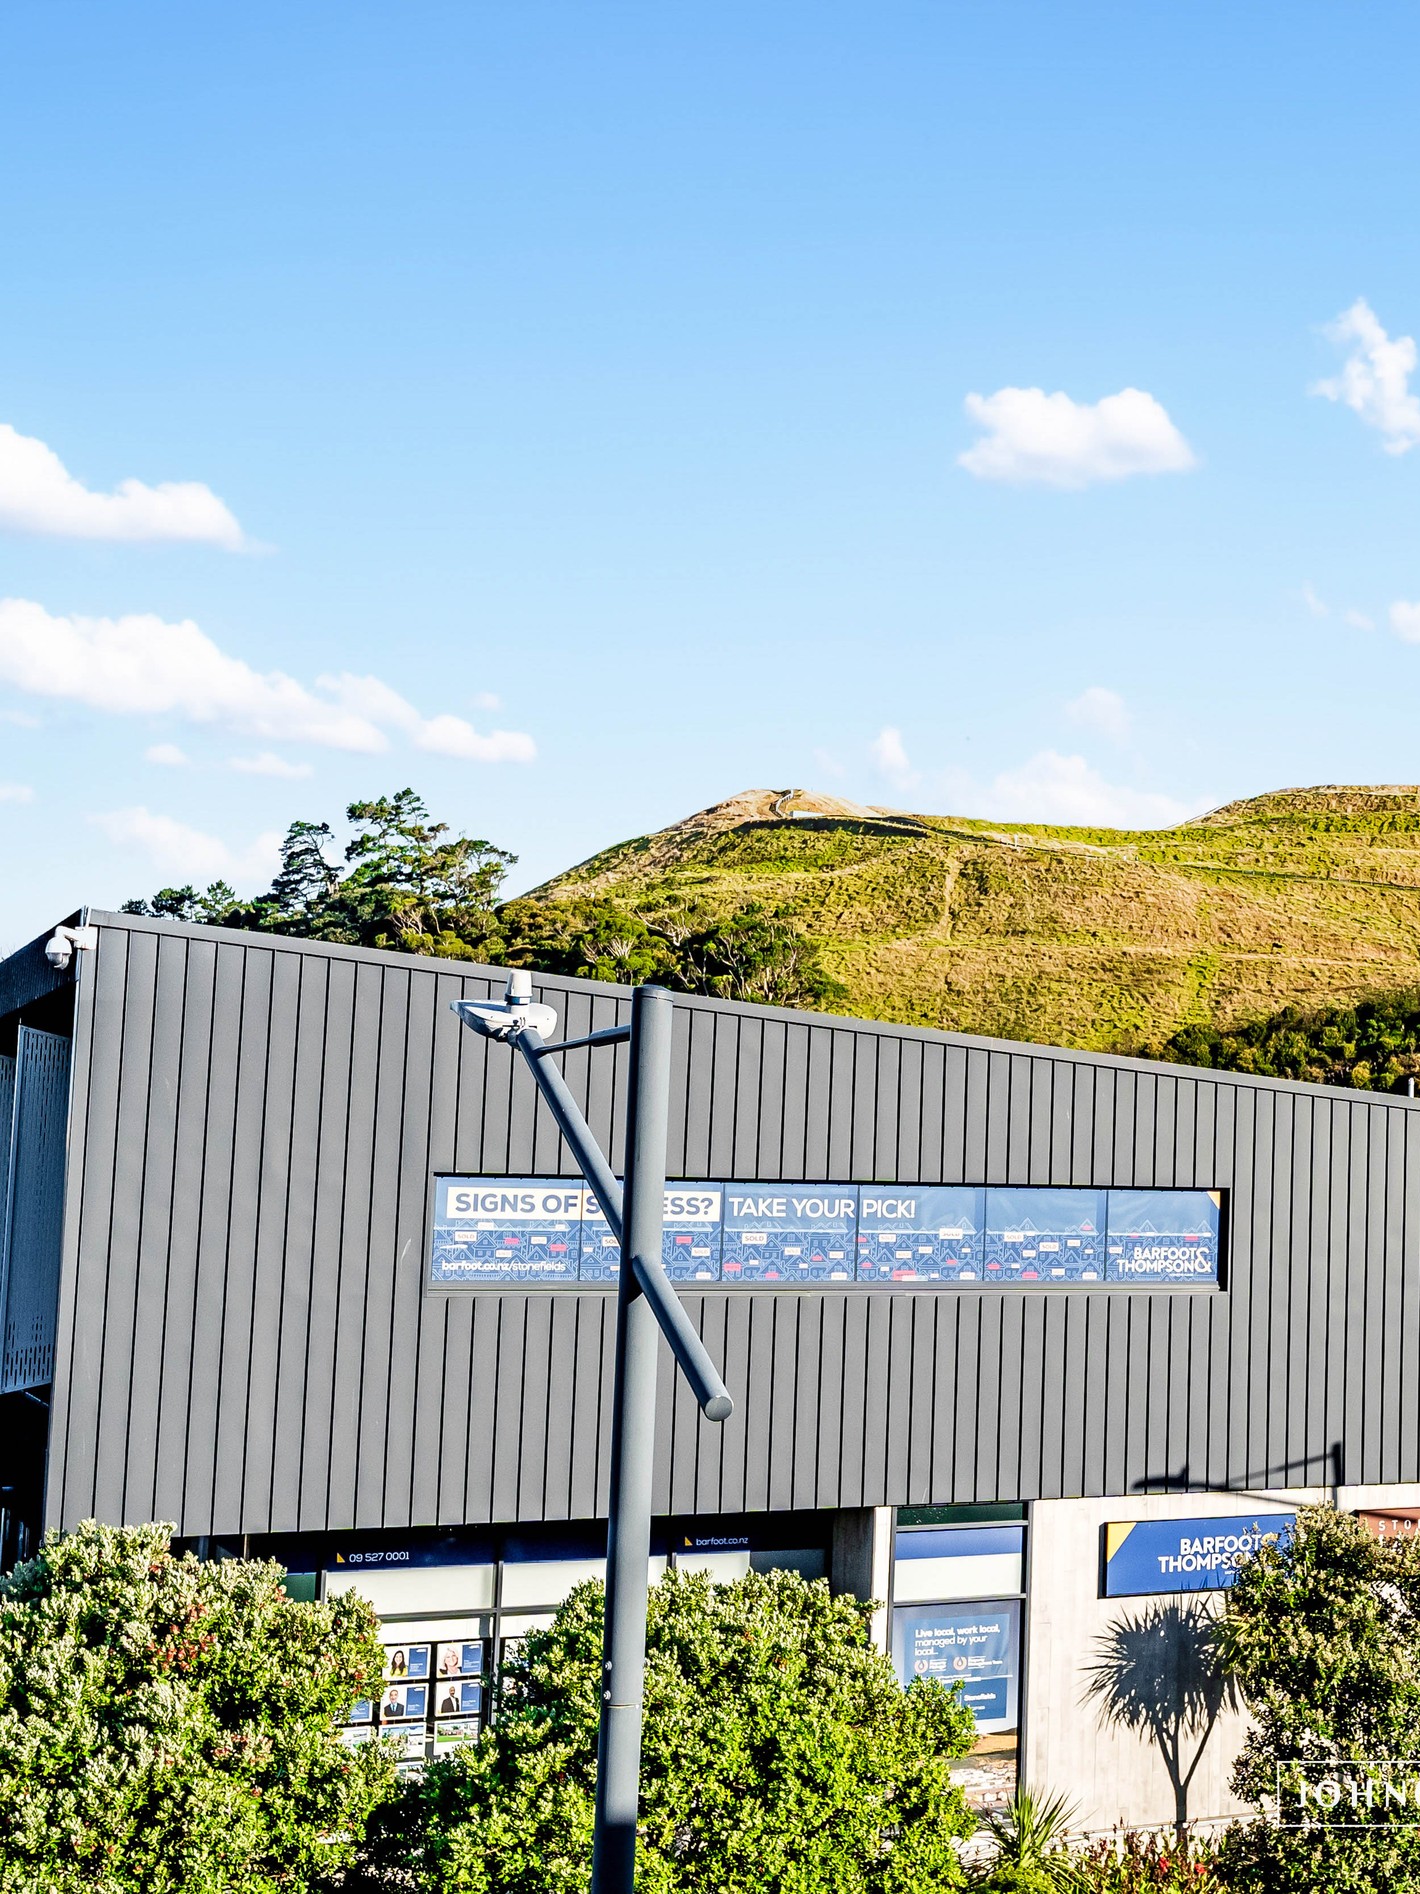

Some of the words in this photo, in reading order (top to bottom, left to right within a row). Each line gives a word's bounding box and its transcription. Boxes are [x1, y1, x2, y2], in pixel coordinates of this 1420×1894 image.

[455, 1192, 535, 1214] SIGNS
[541, 1194, 578, 1213] OF
[728, 1197, 787, 1217] TAKE
[792, 1198, 855, 1219] YOUR
[862, 1199, 916, 1219] PICK!
[744, 1234, 764, 1242] SOLD
[1133, 1246, 1196, 1261] BARFOOT
[441, 1259, 566, 1272] barfoot.co.nz/stonefields
[1117, 1259, 1195, 1273] THOMPSON
[695, 1536, 749, 1547] barfoot.co.nz
[1180, 1533, 1262, 1556] BARFOOT
[348, 1553, 363, 1563] 09
[364, 1552, 384, 1562] 527
[385, 1551, 410, 1561] 0001
[914, 1628, 934, 1638] Live
[956, 1625, 979, 1635] work
[914, 1636, 956, 1648] managed
[957, 1635, 968, 1646] by
[968, 1634, 989, 1646] your
